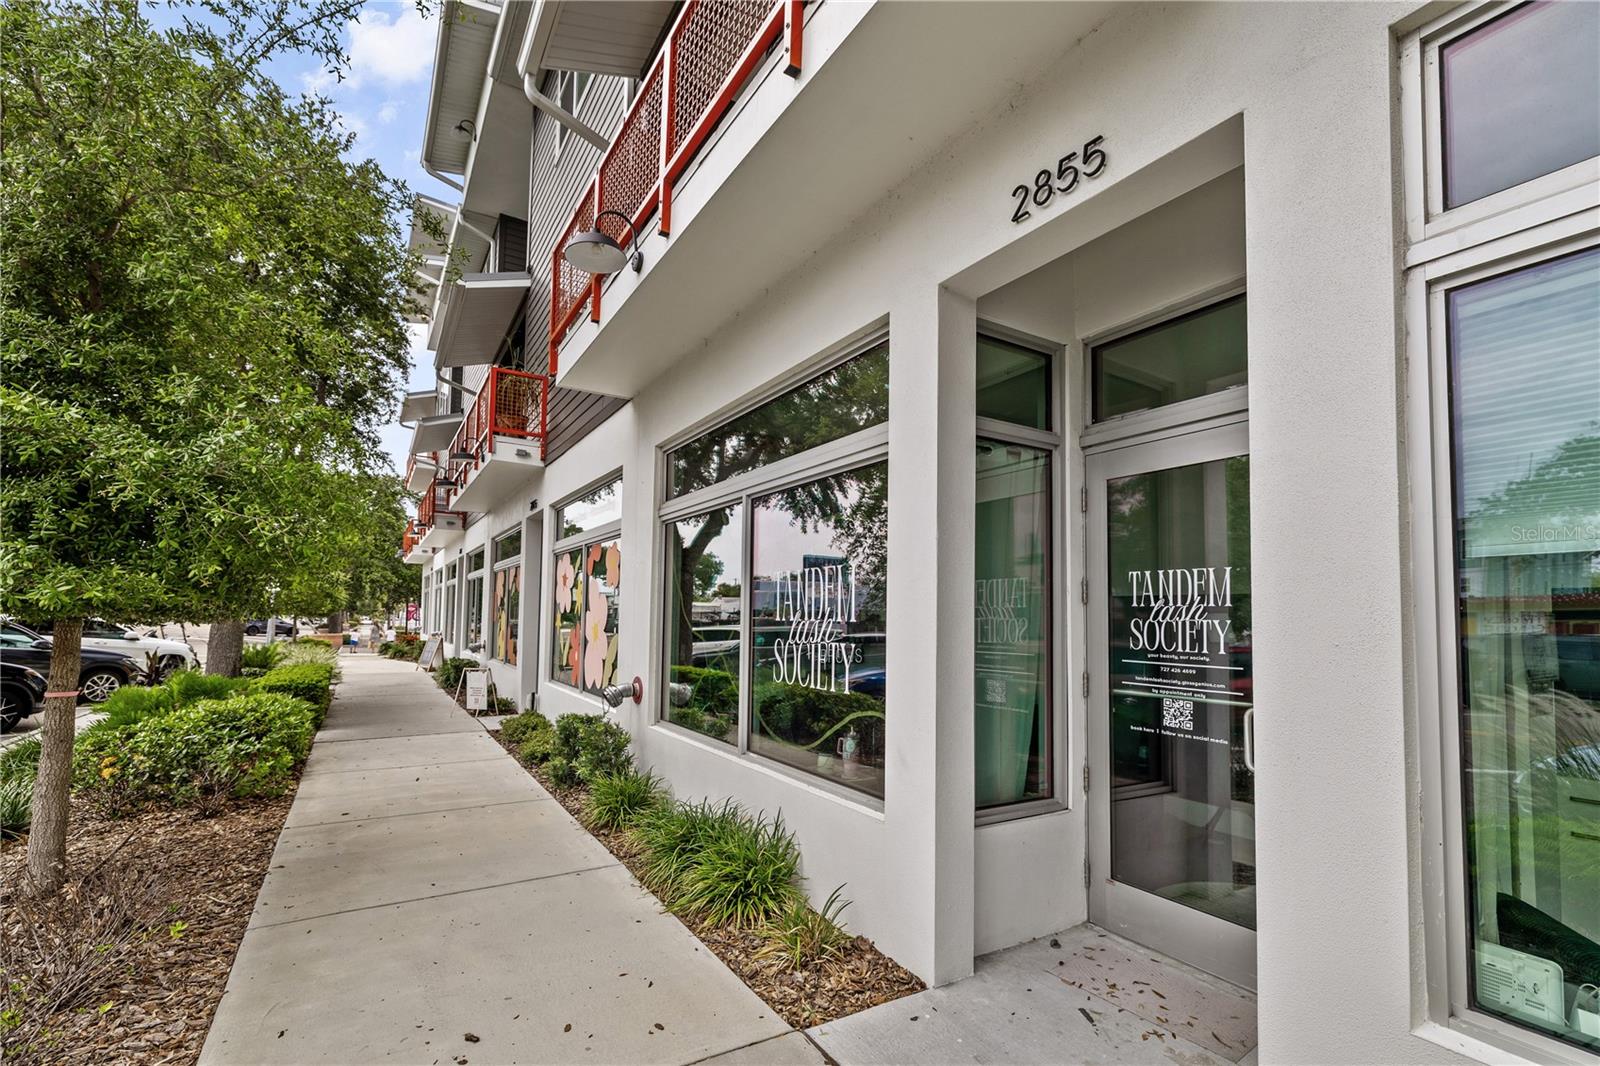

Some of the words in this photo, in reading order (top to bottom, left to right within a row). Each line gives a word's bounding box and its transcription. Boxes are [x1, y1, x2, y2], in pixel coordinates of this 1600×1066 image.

[1011, 135, 1106, 222] 2855
[775, 563, 858, 622] TANDEM
[1128, 567, 1232, 607] TANDEM
[788, 607, 837, 644] lash
[1150, 596, 1208, 623] lash
[1130, 618, 1232, 655] SOCIETY
[773, 638, 856, 694] SOCIETY
[1160, 689, 1193, 697] appointment
[1193, 734, 1209, 742] social
